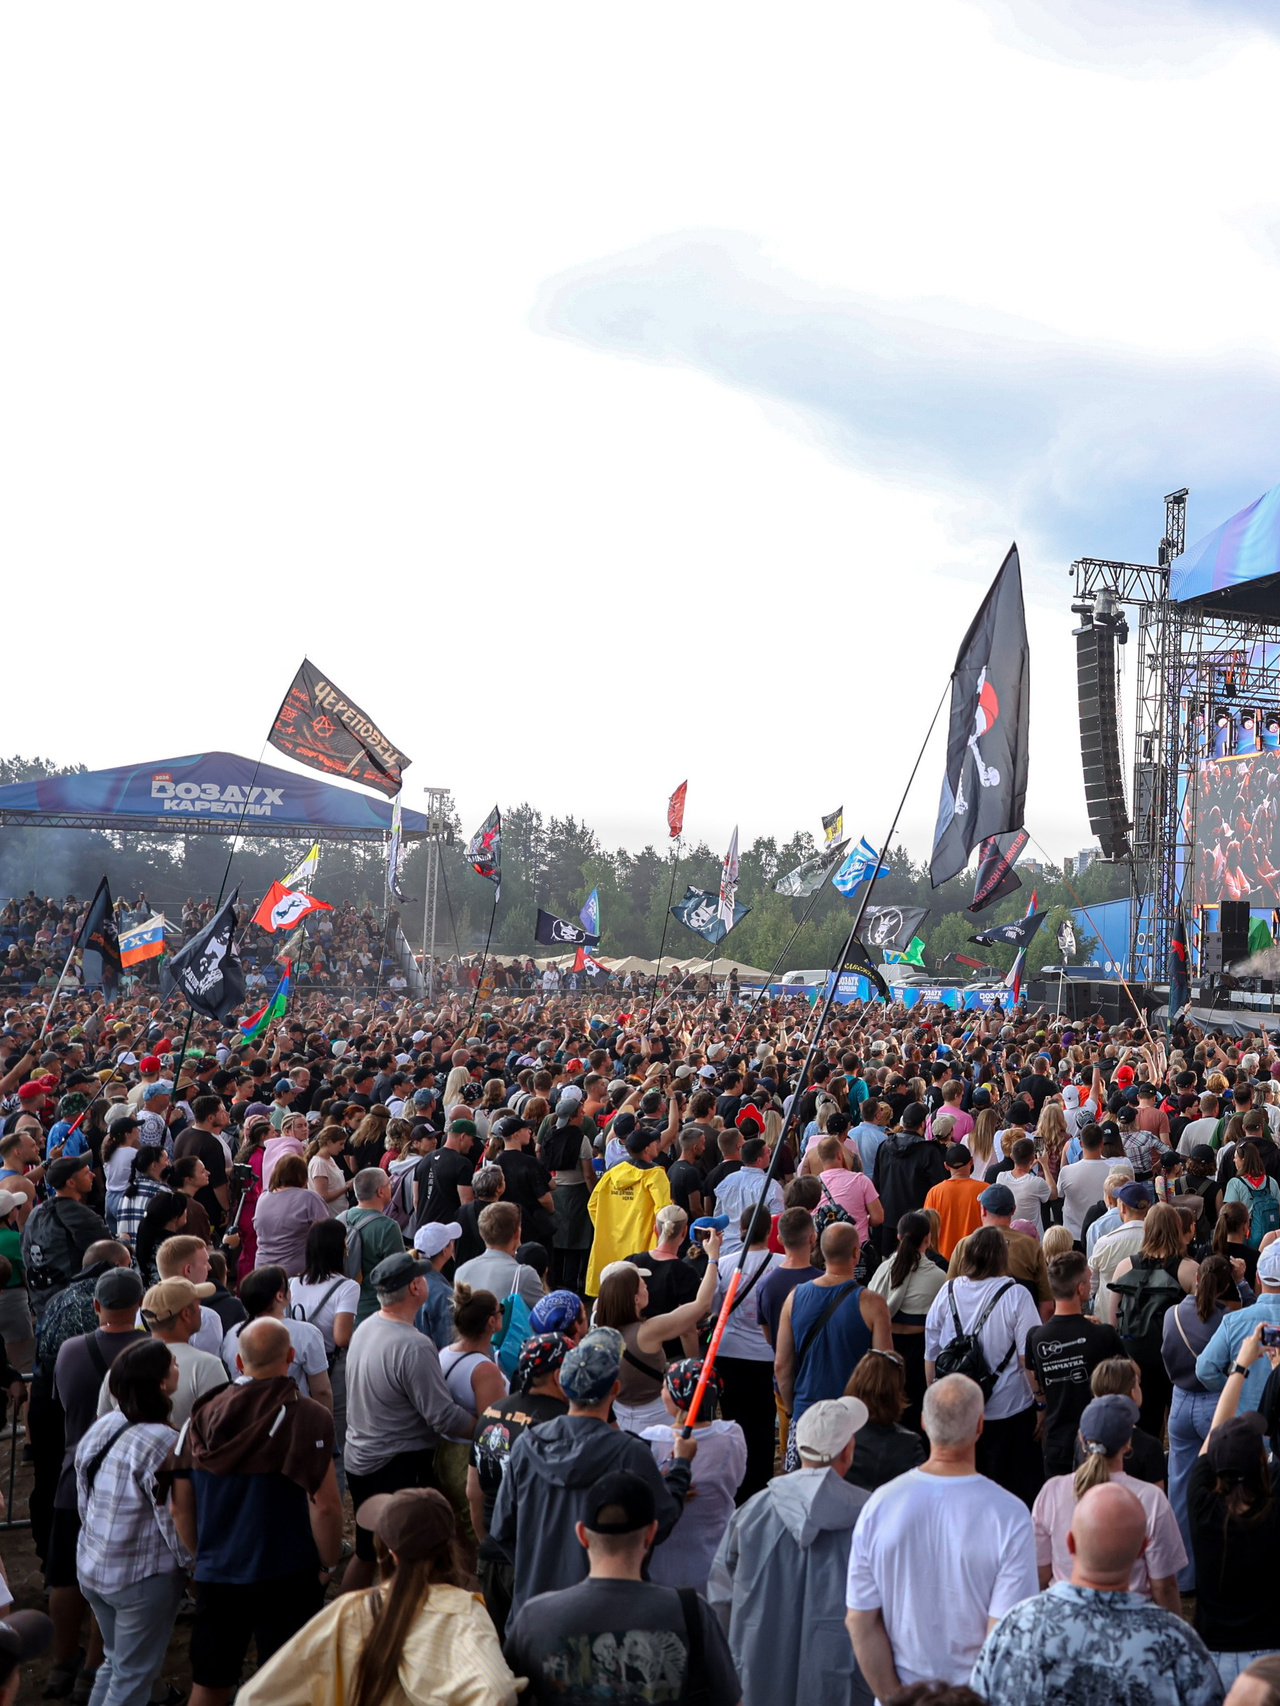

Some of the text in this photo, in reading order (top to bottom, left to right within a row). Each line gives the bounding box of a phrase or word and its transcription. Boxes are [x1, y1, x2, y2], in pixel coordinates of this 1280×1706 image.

[314, 681, 399, 767] ЧЕРЕПОВЕЦ
[151, 780, 285, 805] ВОЗДУХ
[163, 799, 271, 815] КАРЕЛИИ
